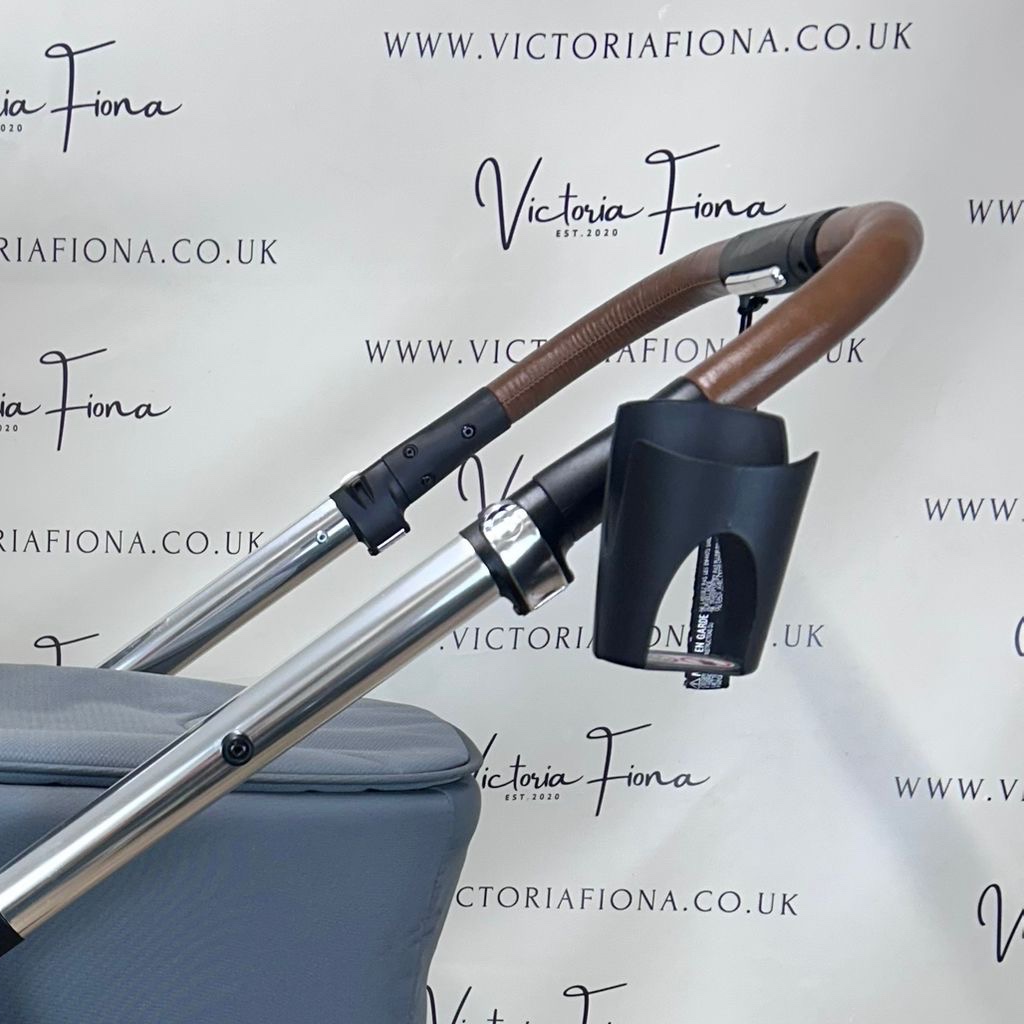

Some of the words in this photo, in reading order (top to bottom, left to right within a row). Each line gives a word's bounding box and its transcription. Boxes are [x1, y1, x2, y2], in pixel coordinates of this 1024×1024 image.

[384, 22, 914, 60] WWW.VICTORIAFIONA.CO.UK
[45, 40, 182, 153] Fiona
[475, 157, 645, 251] Victoria
[645, 144, 787, 255] Fiona
[555, 228, 619, 238] EST.2020
[40, 348, 171, 451] Fiona
[505, 793, 560, 802] EST.2020
[586, 723, 710, 817] Fiona
